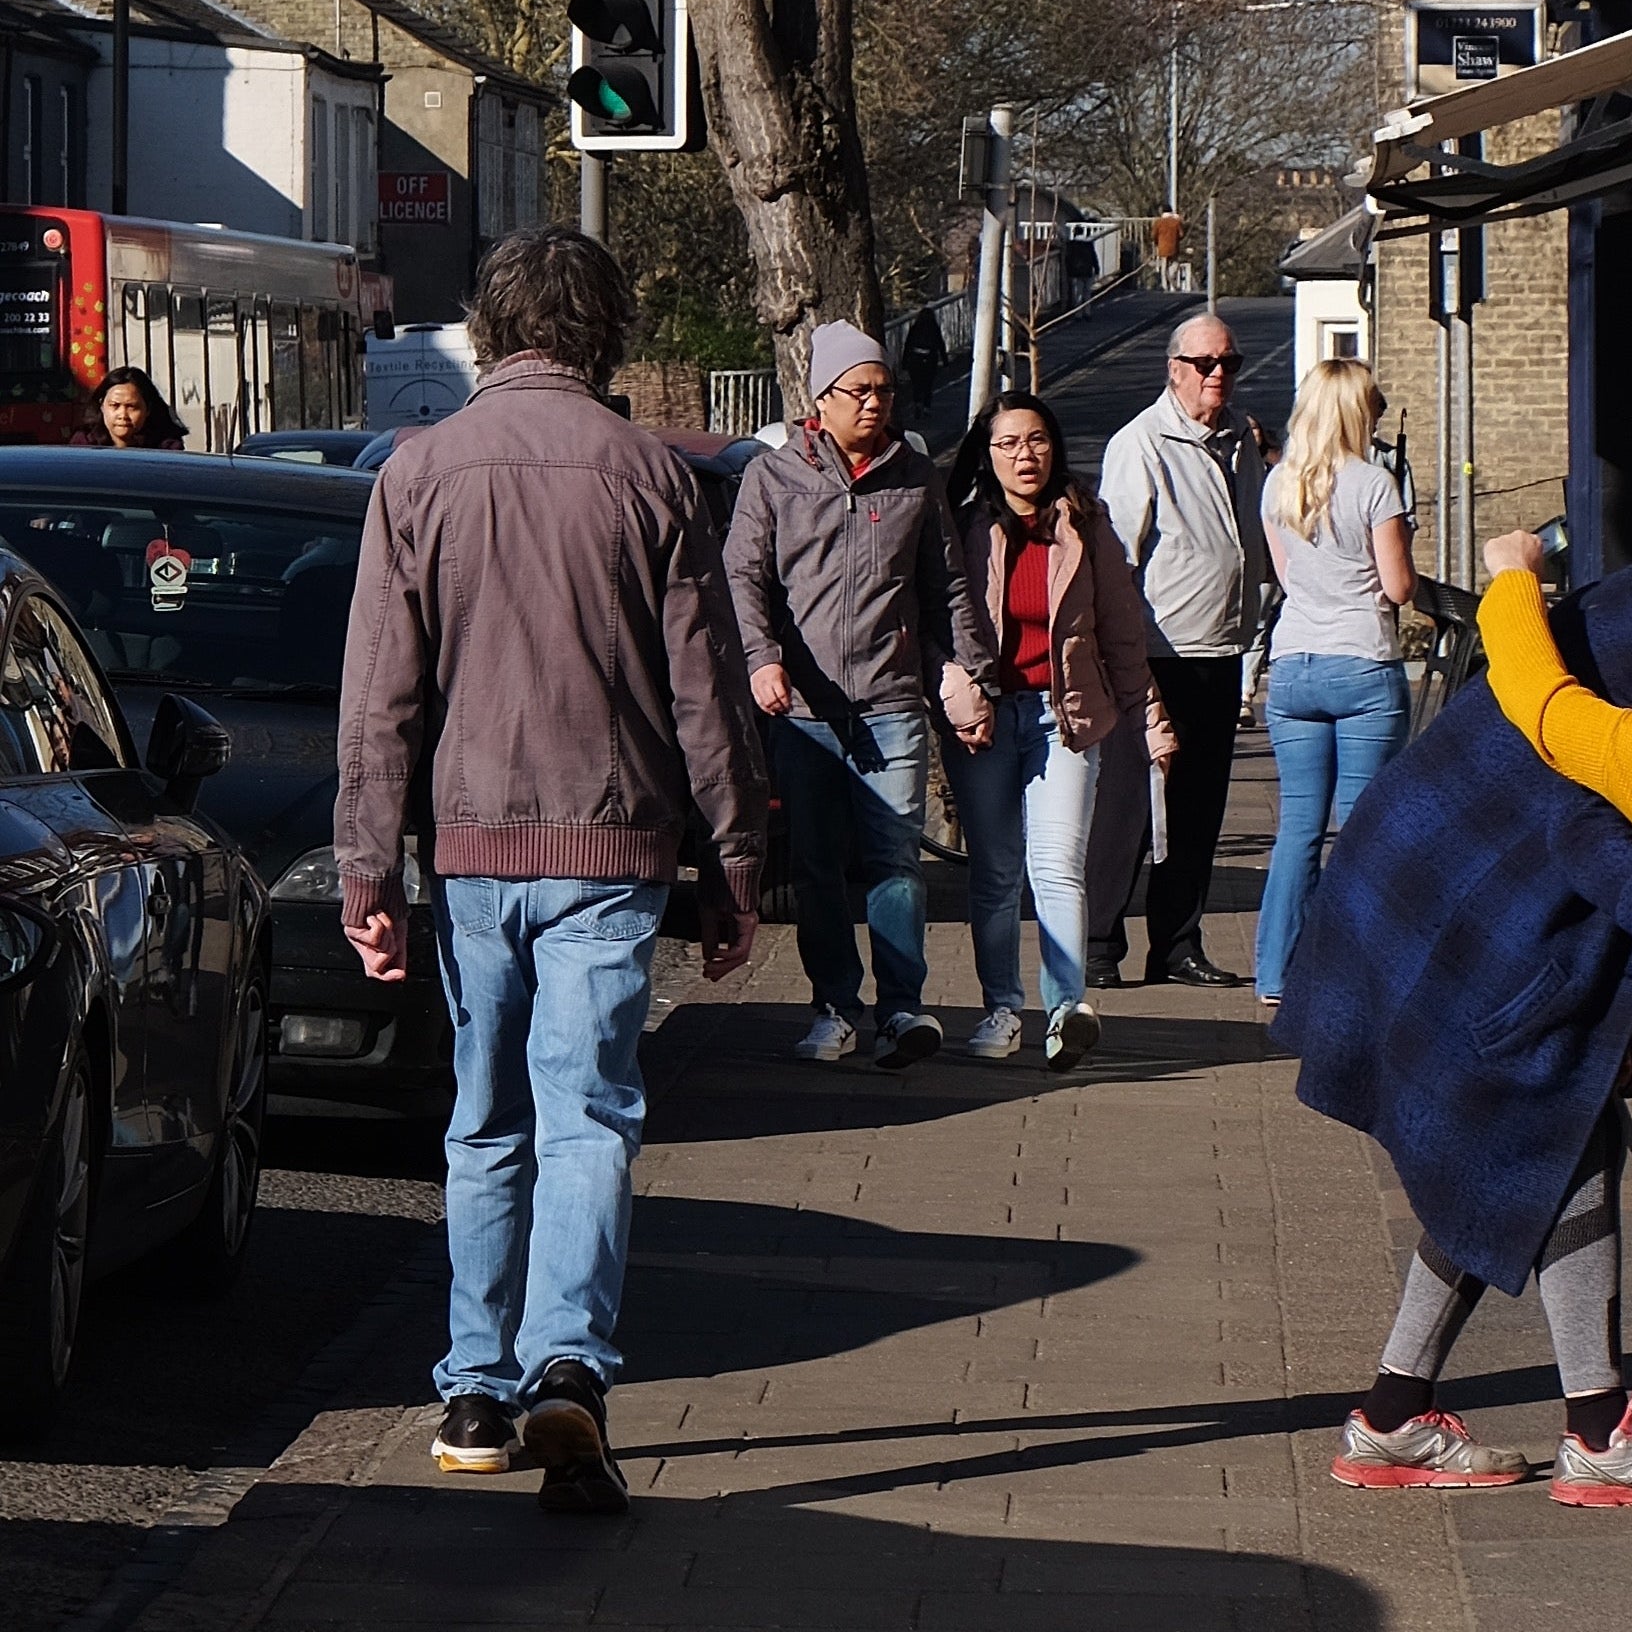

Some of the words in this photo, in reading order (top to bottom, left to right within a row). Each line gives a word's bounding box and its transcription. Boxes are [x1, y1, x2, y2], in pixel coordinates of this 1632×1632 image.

[1457, 52, 1495, 67] Shaw
[397, 176, 429, 195] OFF
[380, 201, 446, 219] LICENCE
